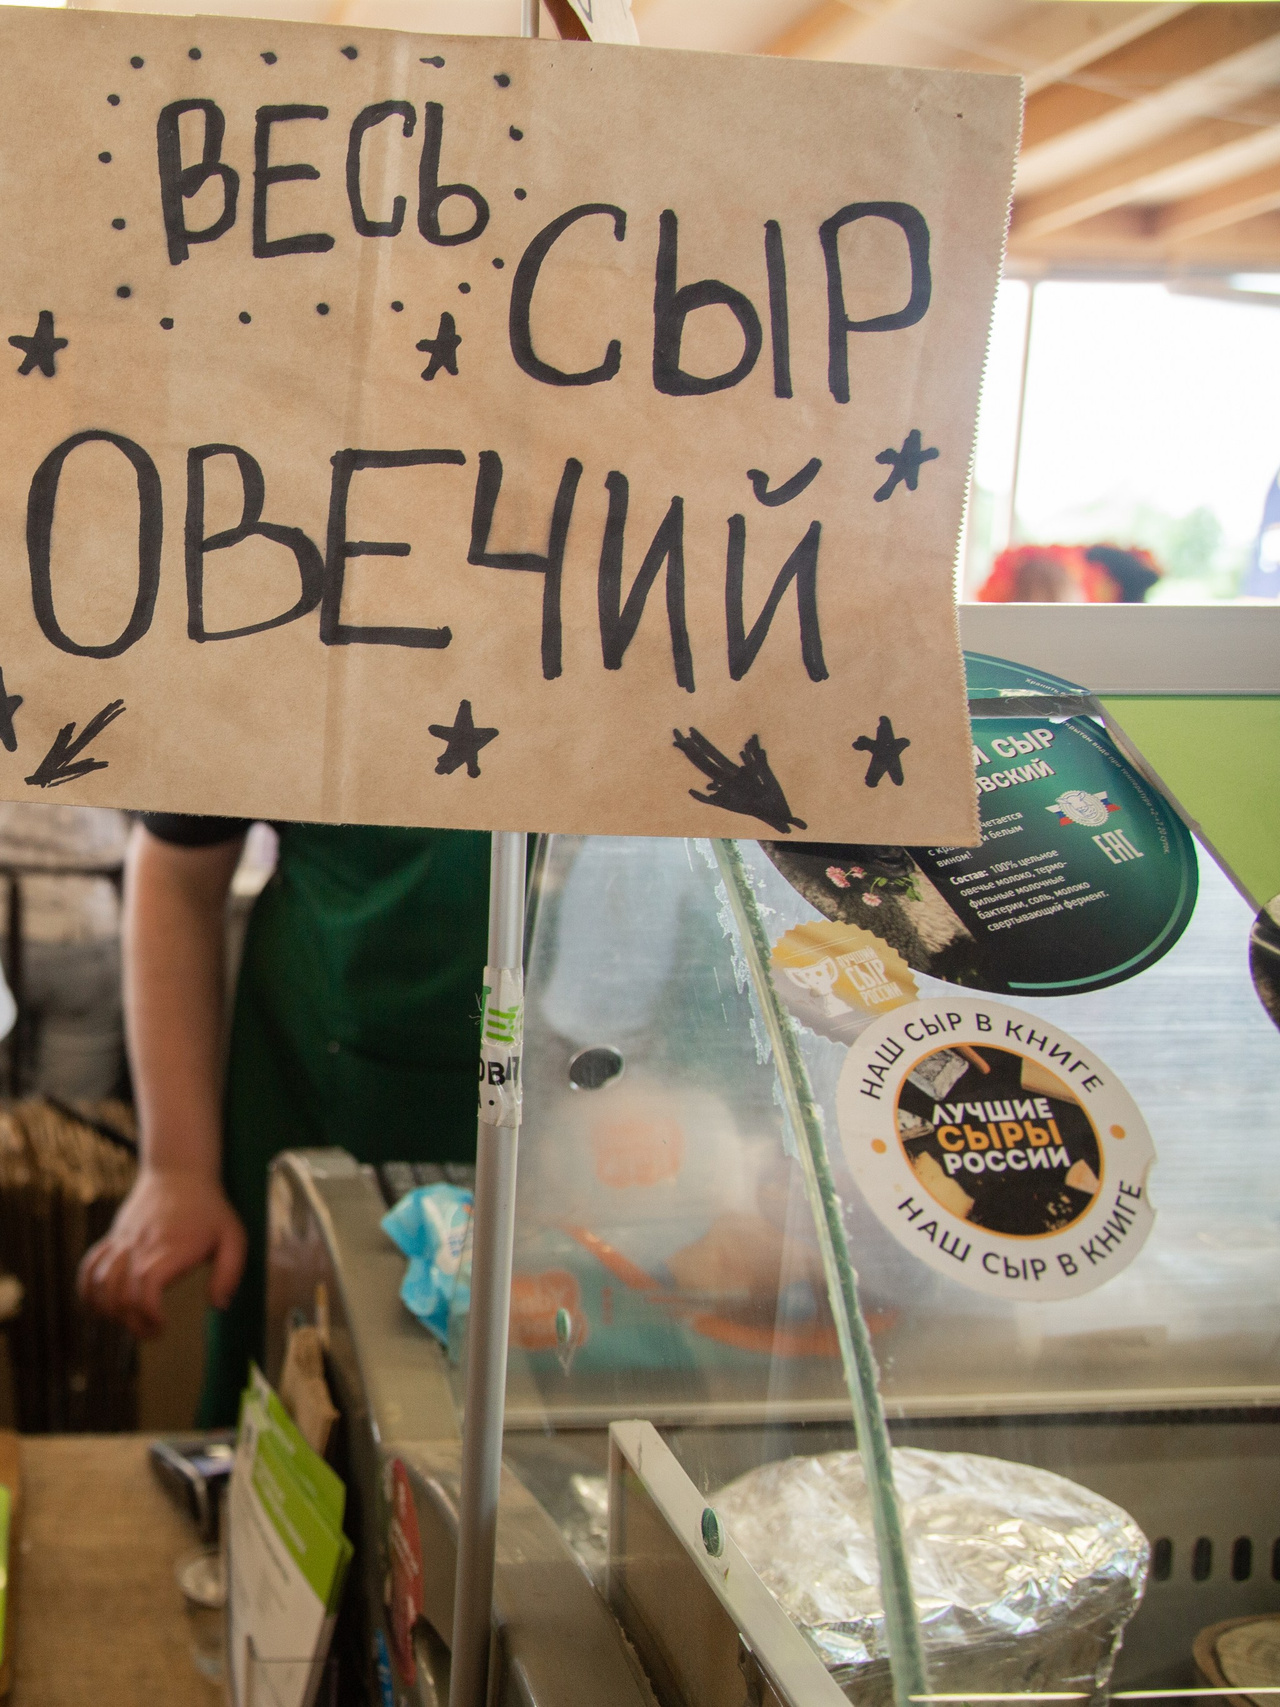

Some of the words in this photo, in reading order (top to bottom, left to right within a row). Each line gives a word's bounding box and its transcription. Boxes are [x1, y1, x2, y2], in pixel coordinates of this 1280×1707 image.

[156, 98, 491, 265] ВЕСЬ
[507, 201, 932, 404] СЫР
[26, 428, 832, 692] ОВЕЧИЙ
[991, 728, 1055, 758] СЫР
[979, 812, 1024, 829] четается
[988, 825, 1024, 839] белым
[936, 850, 973, 868] вином!
[950, 869, 989, 886] Состав:
[990, 860, 1019, 874] 100%
[1018, 849, 1059, 867] цельное
[960, 881, 995, 897] овечье
[995, 870, 1036, 887] молоко,
[1034, 860, 1068, 876] термо-
[969, 890, 1016, 910] фильные
[1015, 875, 1066, 895] молочные
[976, 901, 1029, 920] бактерии,
[1028, 893, 1055, 906] соль,
[1053, 881, 1091, 898] молоко
[987, 903, 1064, 932] свертывающий
[1063, 889, 1110, 910] фермент.
[835, 944, 879, 969] ЛУЧШИЙ
[844, 958, 889, 991] СЫР
[859, 981, 904, 1007] РОССИИ
[860, 1037, 905, 1100] НАШ
[904, 1011, 962, 1042] СЫР
[975, 1013, 993, 1032] В
[1005, 1019, 1104, 1093] КНИГЕ
[931, 1098, 1053, 1126] ЛУЧШИЕ
[937, 1120, 1063, 1152] СЫРЫ
[942, 1147, 1071, 1175] РОССИИ
[897, 1197, 971, 1262] НАШ
[981, 1251, 1047, 1281] СЫР
[1056, 1253, 1078, 1277] В
[1079, 1180, 1142, 1265] КНИГЕ
